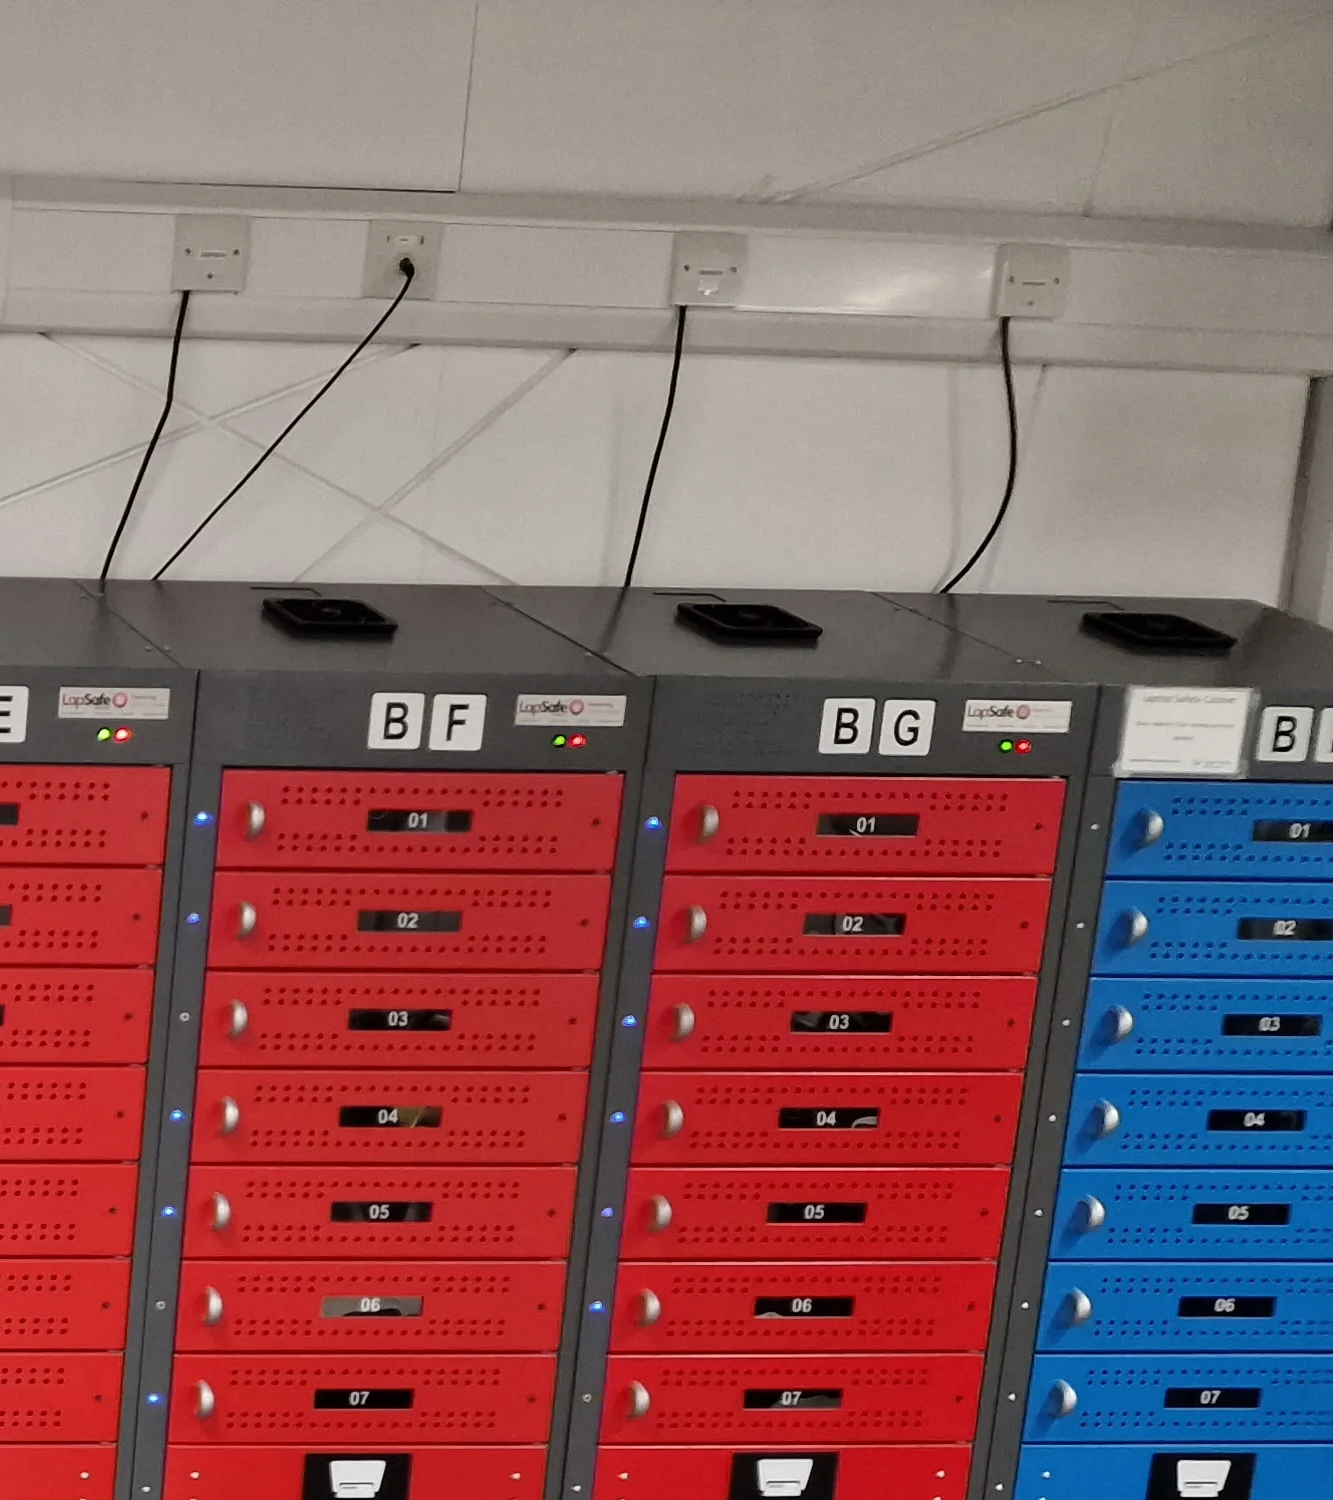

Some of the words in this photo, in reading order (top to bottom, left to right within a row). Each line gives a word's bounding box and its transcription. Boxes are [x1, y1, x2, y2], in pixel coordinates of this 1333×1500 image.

[408, 812, 428, 828] 01
[856, 816, 876, 833] 01
[1289, 822, 1311, 839] 01
[397, 912, 419, 929] 02
[842, 915, 864, 932] 02
[1273, 920, 1297, 936] 02
[388, 1010, 409, 1027] 03
[829, 1014, 850, 1030] 03
[377, 1108, 399, 1124] 04
[816, 1110, 837, 1126] 04
[369, 1204, 390, 1220] 05
[804, 1204, 825, 1220] 05
[1228, 1205, 1249, 1221] 05
[360, 1297, 381, 1313] 06
[791, 1298, 812, 1313] 06
[1213, 1297, 1236, 1313] 06
[348, 1391, 370, 1406] 07
[780, 1391, 802, 1406] 07
[1200, 1390, 1222, 1405] 07
